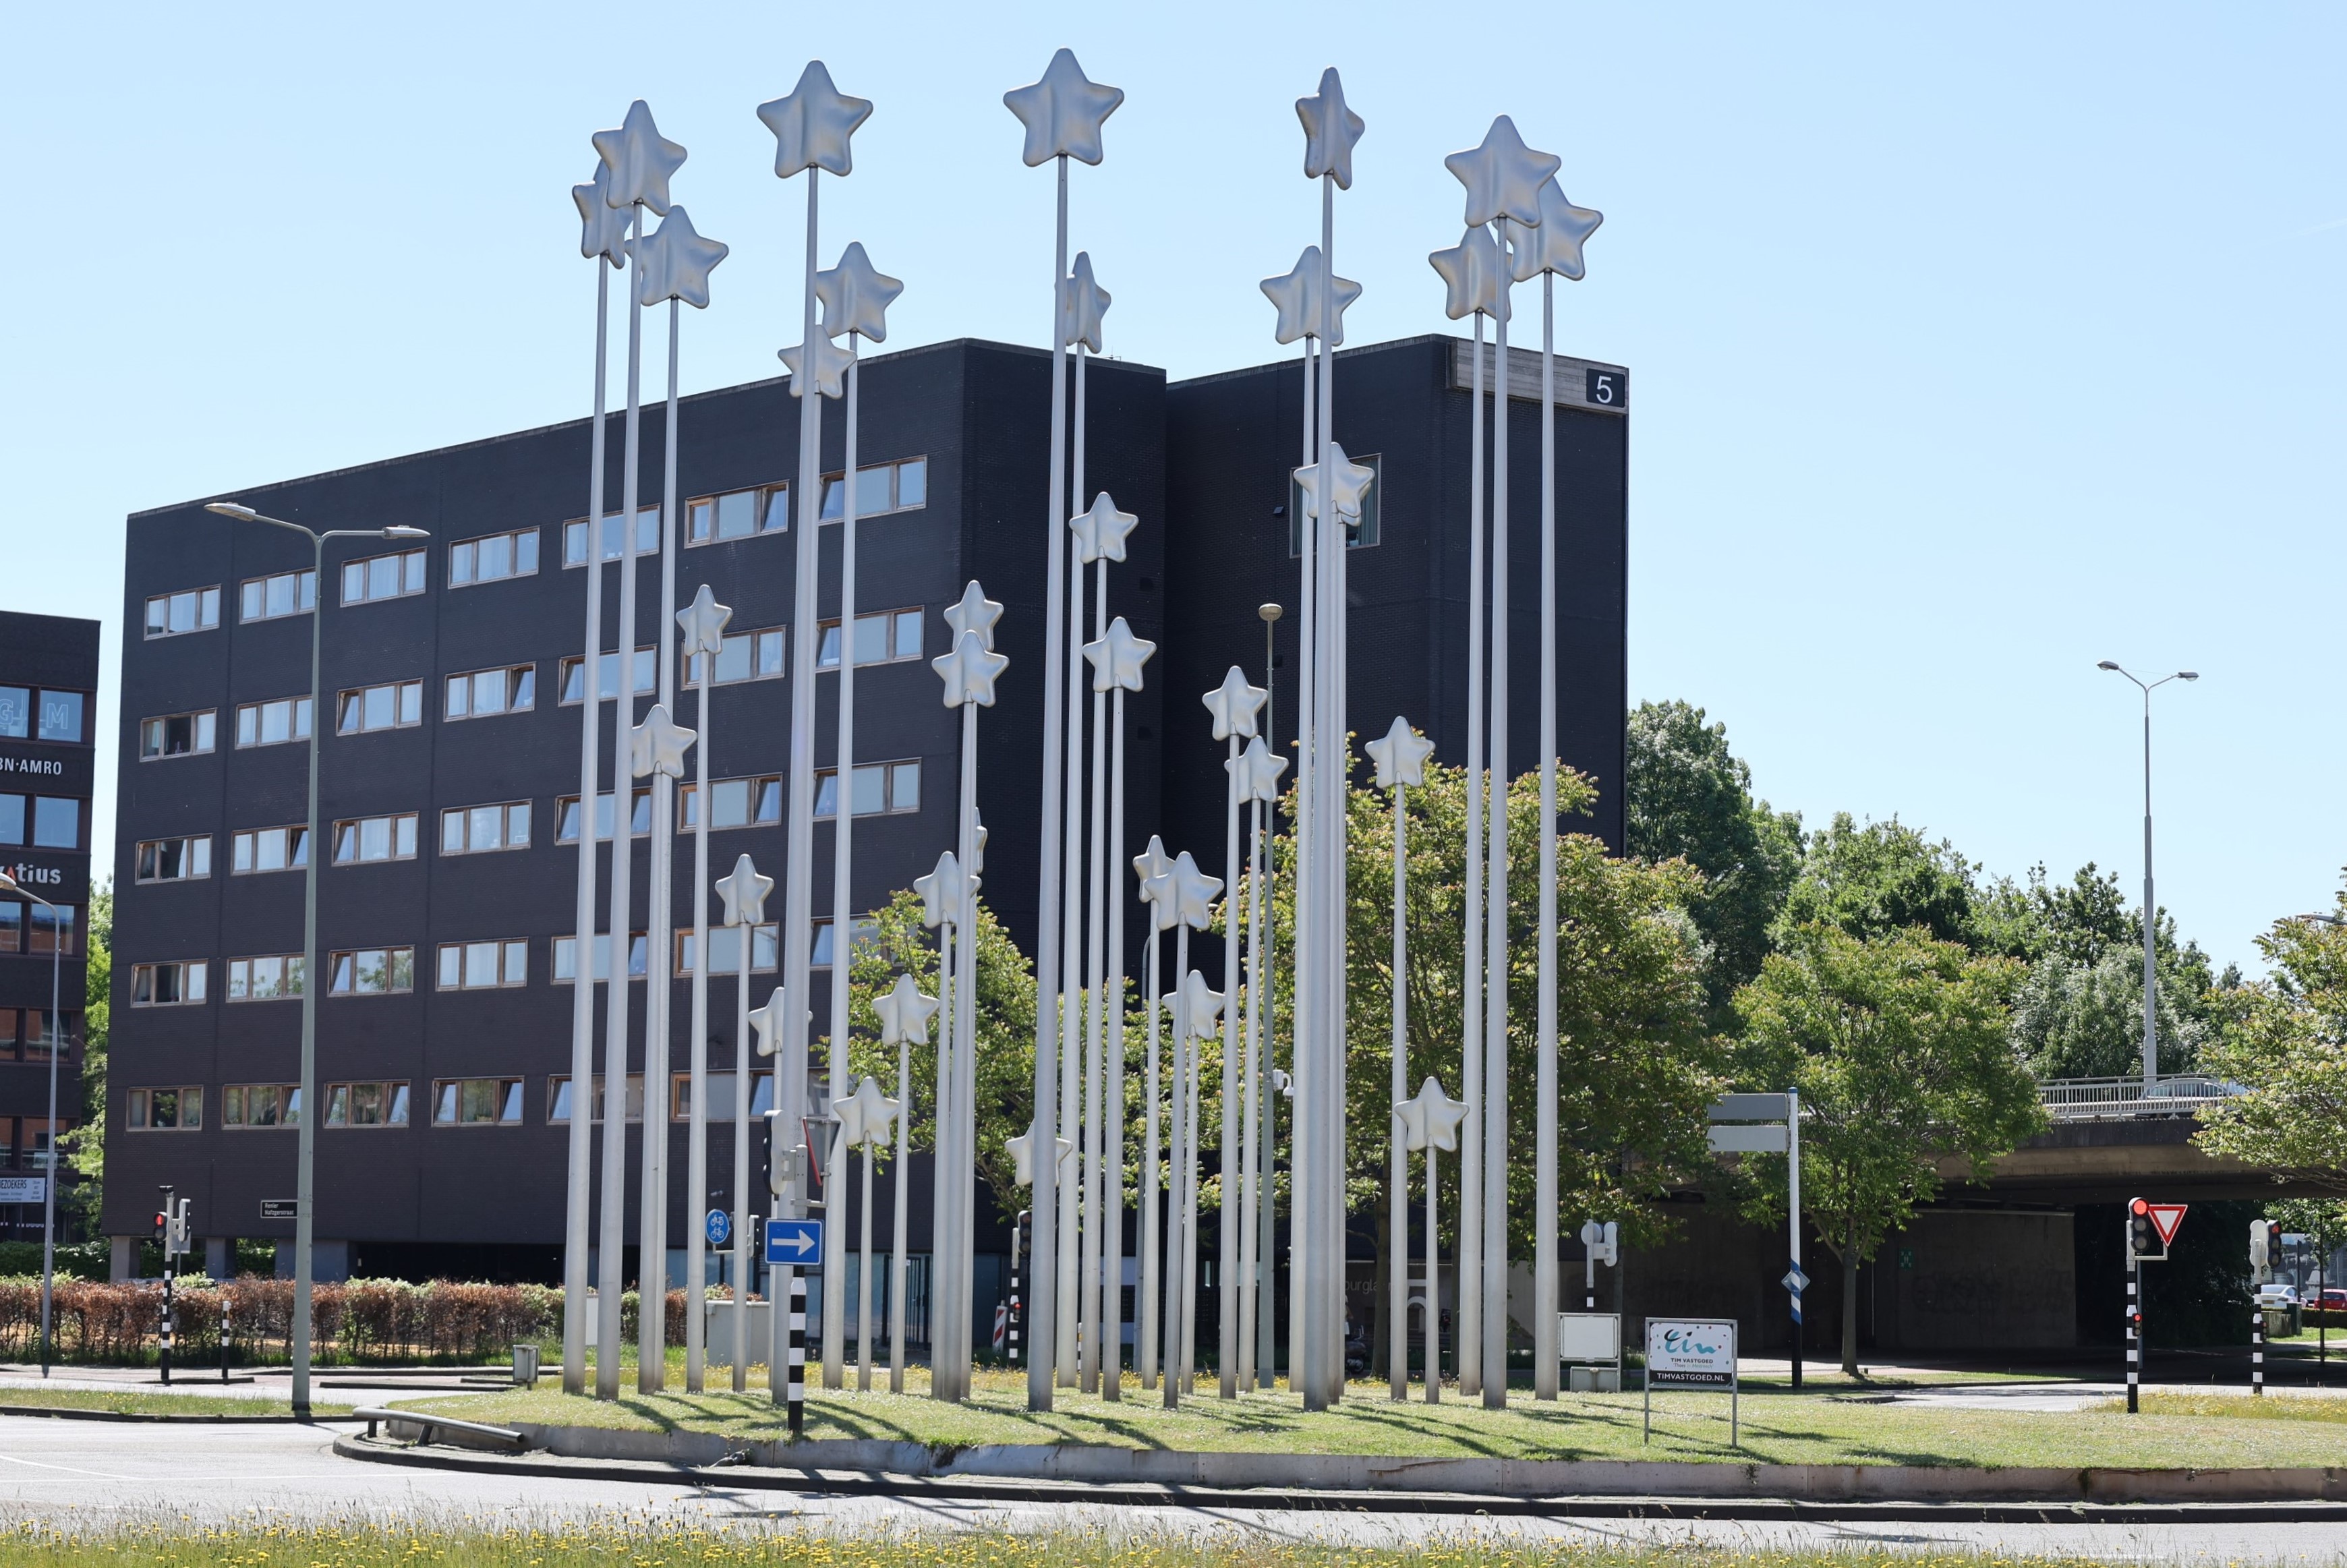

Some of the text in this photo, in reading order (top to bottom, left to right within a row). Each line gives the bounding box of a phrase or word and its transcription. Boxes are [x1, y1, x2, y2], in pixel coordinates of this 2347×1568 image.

[1596, 375, 1613, 404] 5
[0, 1179, 27, 1189] EZOEKERS
[1657, 1372, 1725, 1381] TIMVASTGOED.NL
